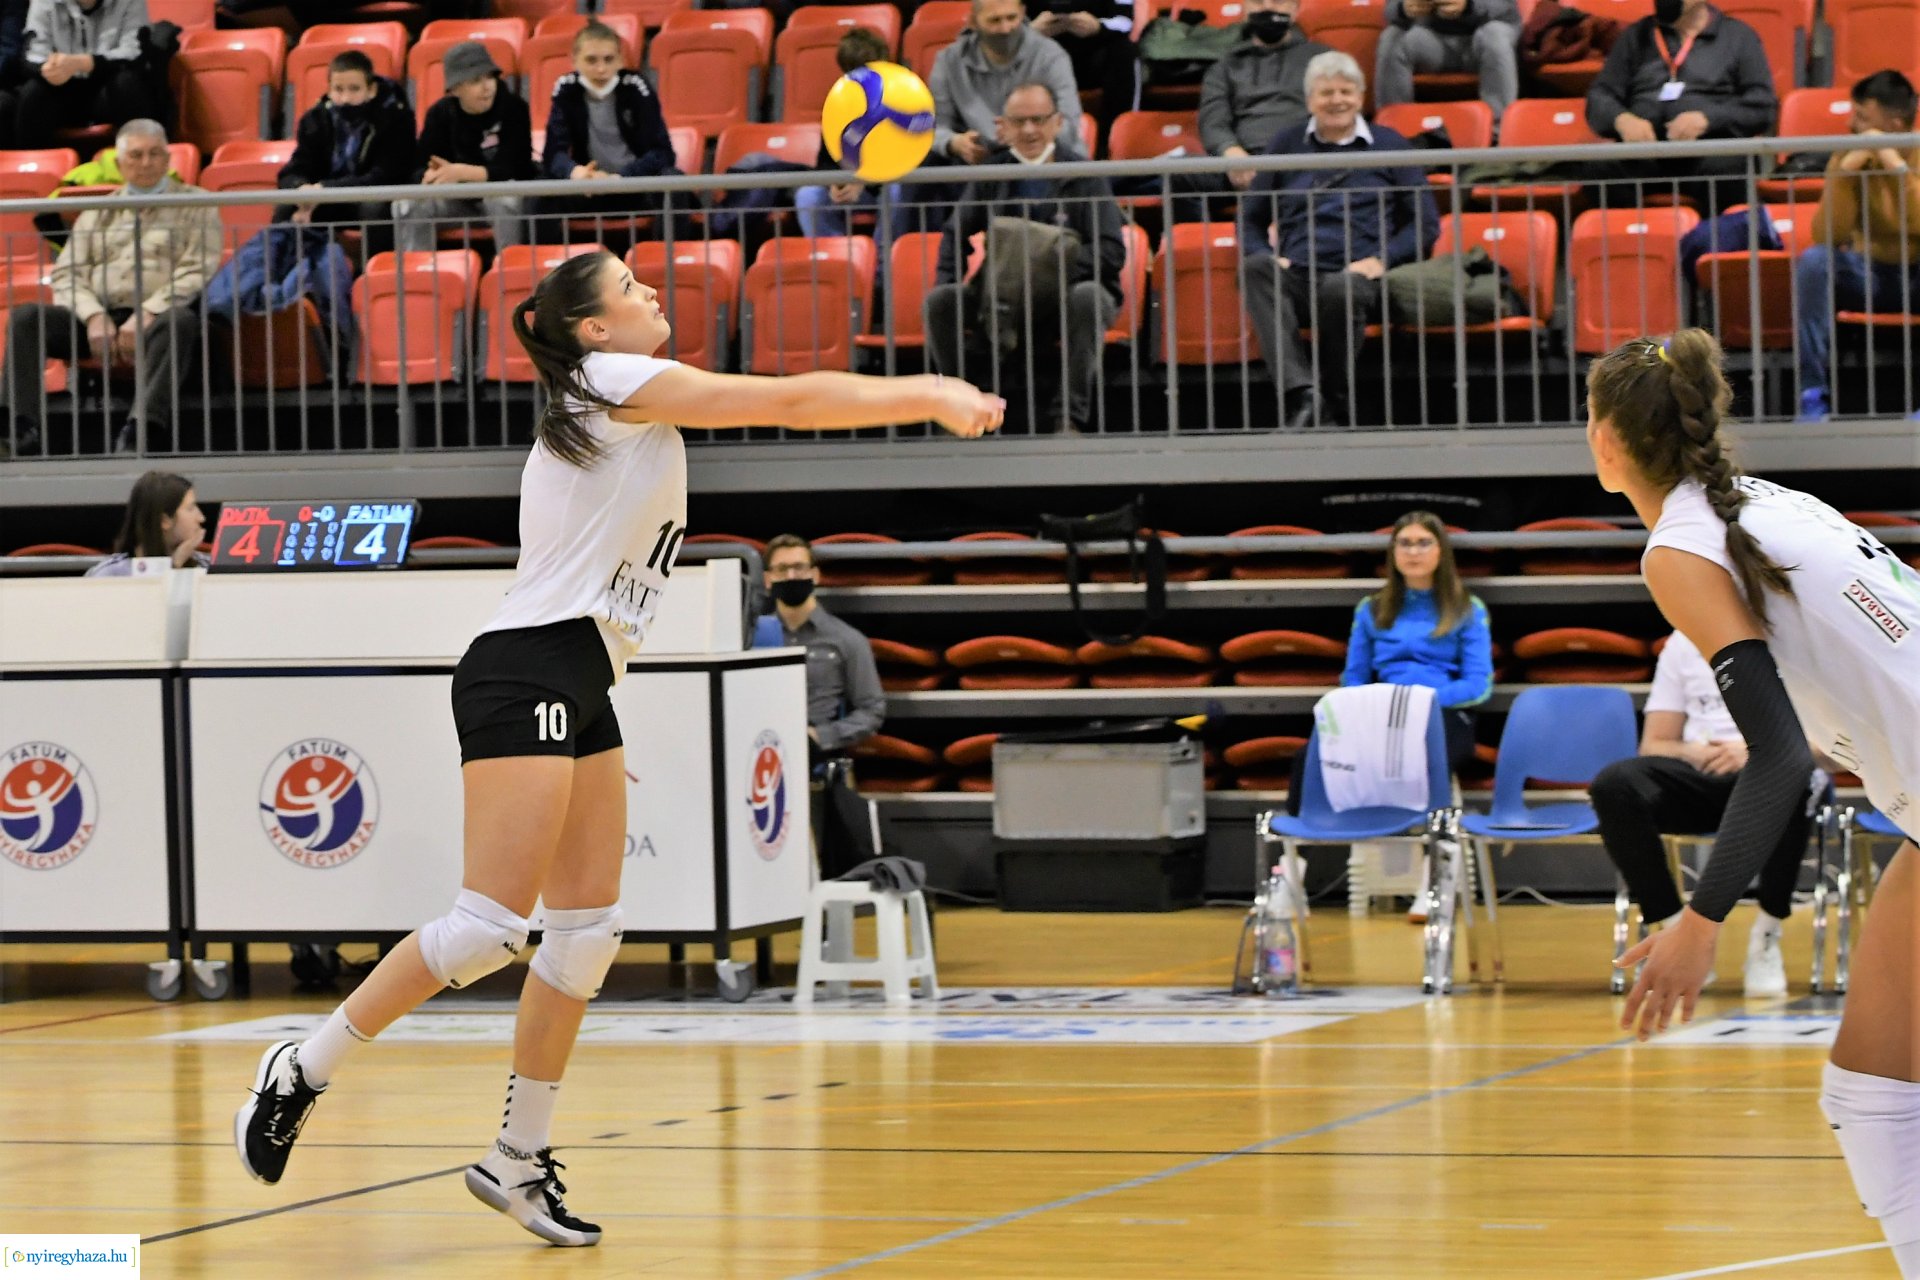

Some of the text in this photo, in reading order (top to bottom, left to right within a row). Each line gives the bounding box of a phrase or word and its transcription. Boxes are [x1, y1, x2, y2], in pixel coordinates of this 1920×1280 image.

[348, 505, 412, 521] FATUM
[229, 524, 260, 563] 4
[353, 523, 387, 562] 4
[611, 560, 663, 609] FAT
[535, 701, 567, 741] 10
[10, 745, 67, 762] FATUM
[288, 742, 348, 760] FATUM
